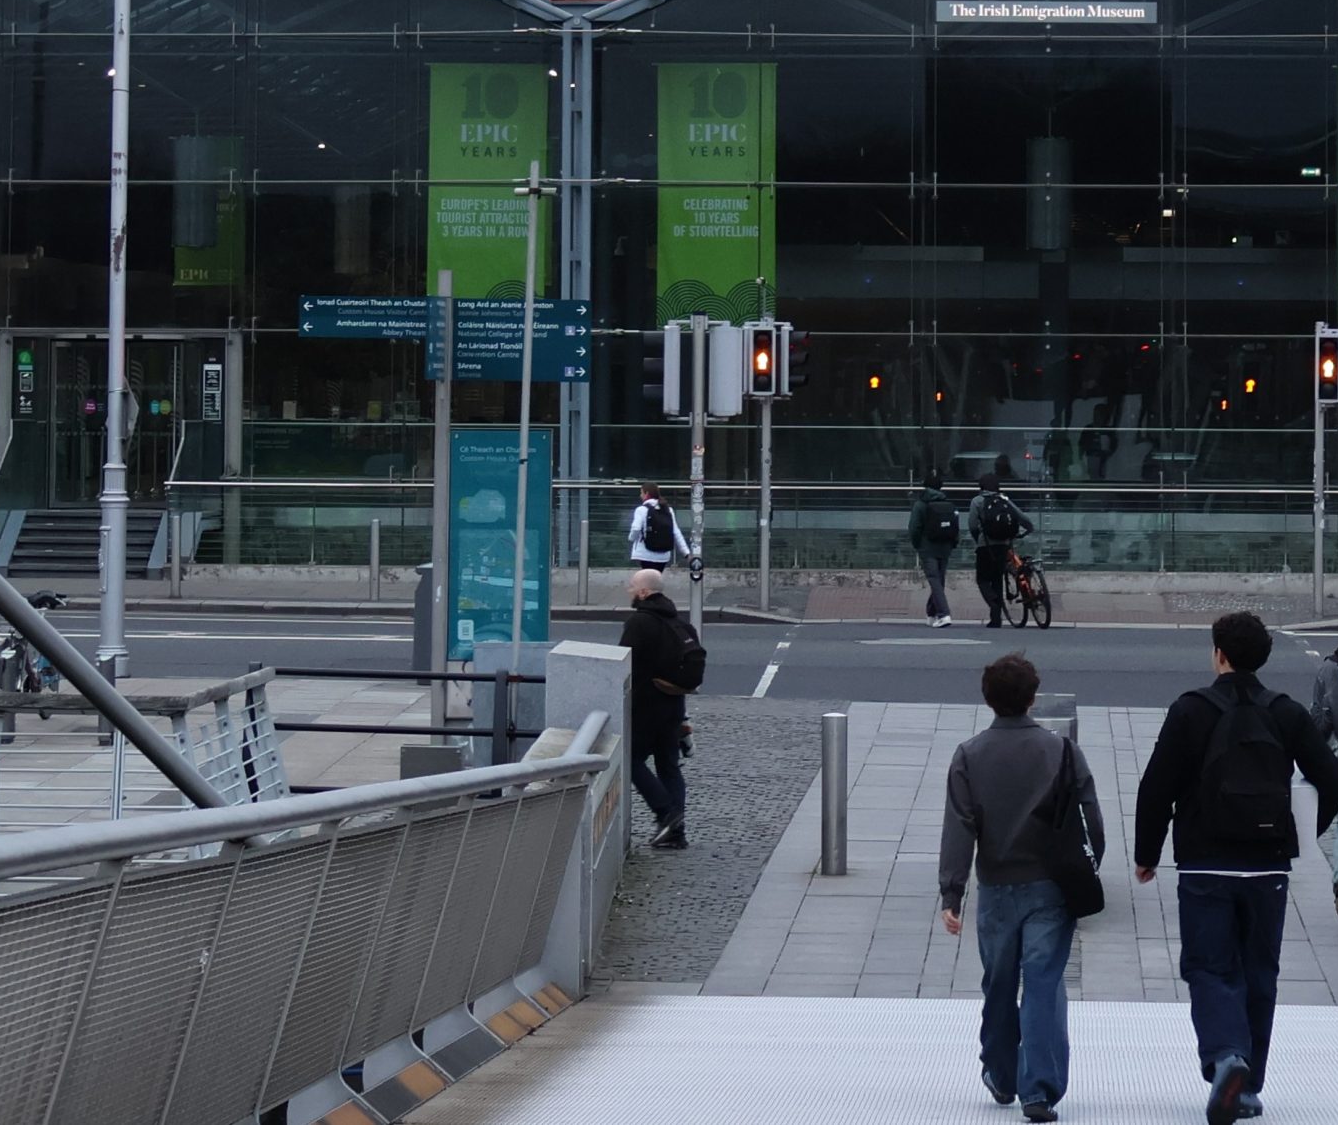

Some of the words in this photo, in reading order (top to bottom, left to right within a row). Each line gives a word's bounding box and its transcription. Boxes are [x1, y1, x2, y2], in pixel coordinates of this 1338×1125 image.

[949, 4, 976, 17] The
[979, 4, 1009, 17] Irish
[1012, 5, 1084, 20] Emigration
[1087, 5, 1145, 18] Museum
[462, 73, 519, 119] 10
[689, 71, 747, 118] 10
[461, 124, 517, 143] EPIC
[689, 123, 746, 142] EPIC
[461, 146, 517, 158] YEARS
[689, 146, 746, 158] YEARS
[441, 198, 489, 210] EUROPE'S
[492, 199, 530, 211] LEADIN
[683, 198, 749, 210] CELEBRATING
[436, 212, 476, 224] TOURIST
[479, 212, 530, 224] ATTRACTIO
[693, 212, 706, 224] 10
[708, 212, 740, 224] YEARS
[442, 225, 449, 237] 3
[452, 225, 482, 237] YEARS
[485, 225, 494, 237] IN
[496, 225, 504, 237] A
[507, 225, 530, 237] ROW
[673, 225, 686, 237] OF
[689, 225, 759, 237] STORYTELLING
[457, 301, 475, 309] Long
[388, 320, 427, 328] Mainistreac
[497, 350, 520, 358] Centre
